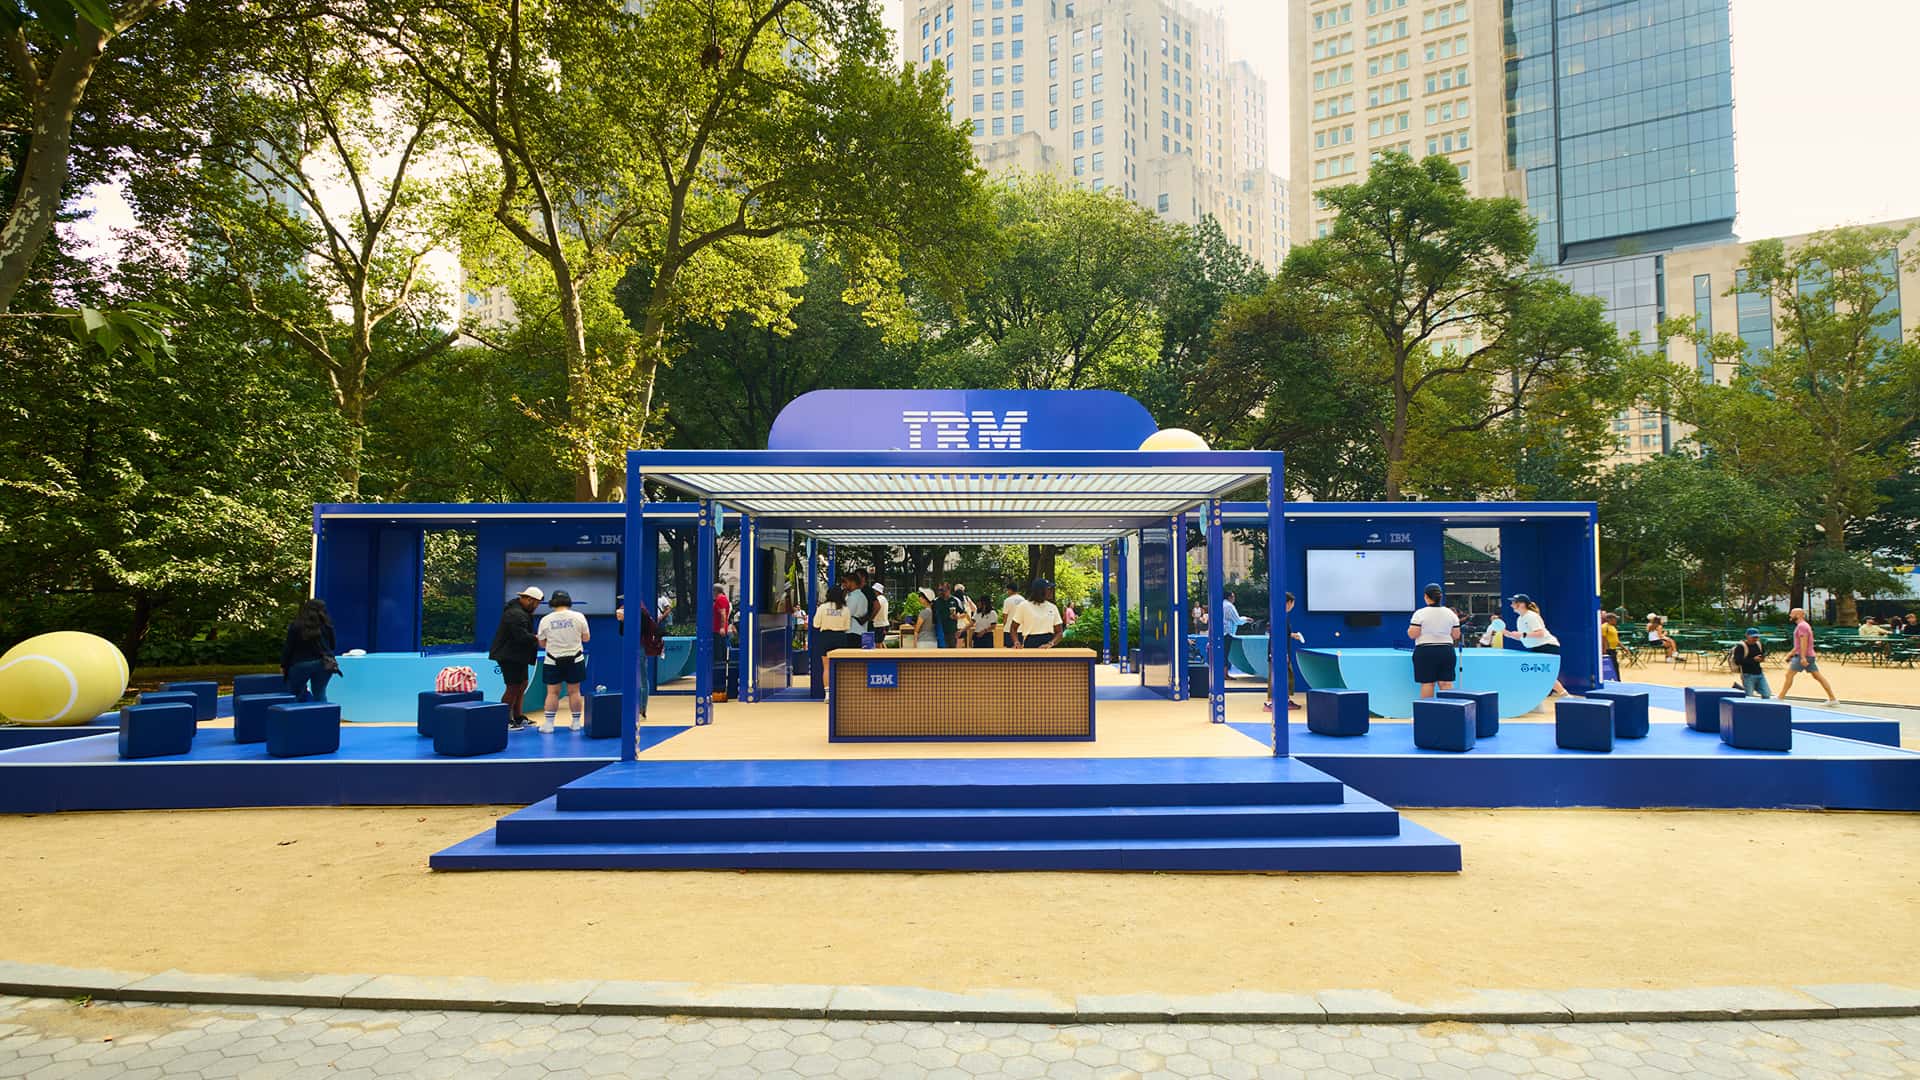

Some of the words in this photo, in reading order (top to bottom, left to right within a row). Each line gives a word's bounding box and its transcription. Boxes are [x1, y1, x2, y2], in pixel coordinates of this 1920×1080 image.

[601, 535, 622, 545] IBM
[1390, 533, 1411, 543] IBM
[870, 674, 894, 685] IBM
